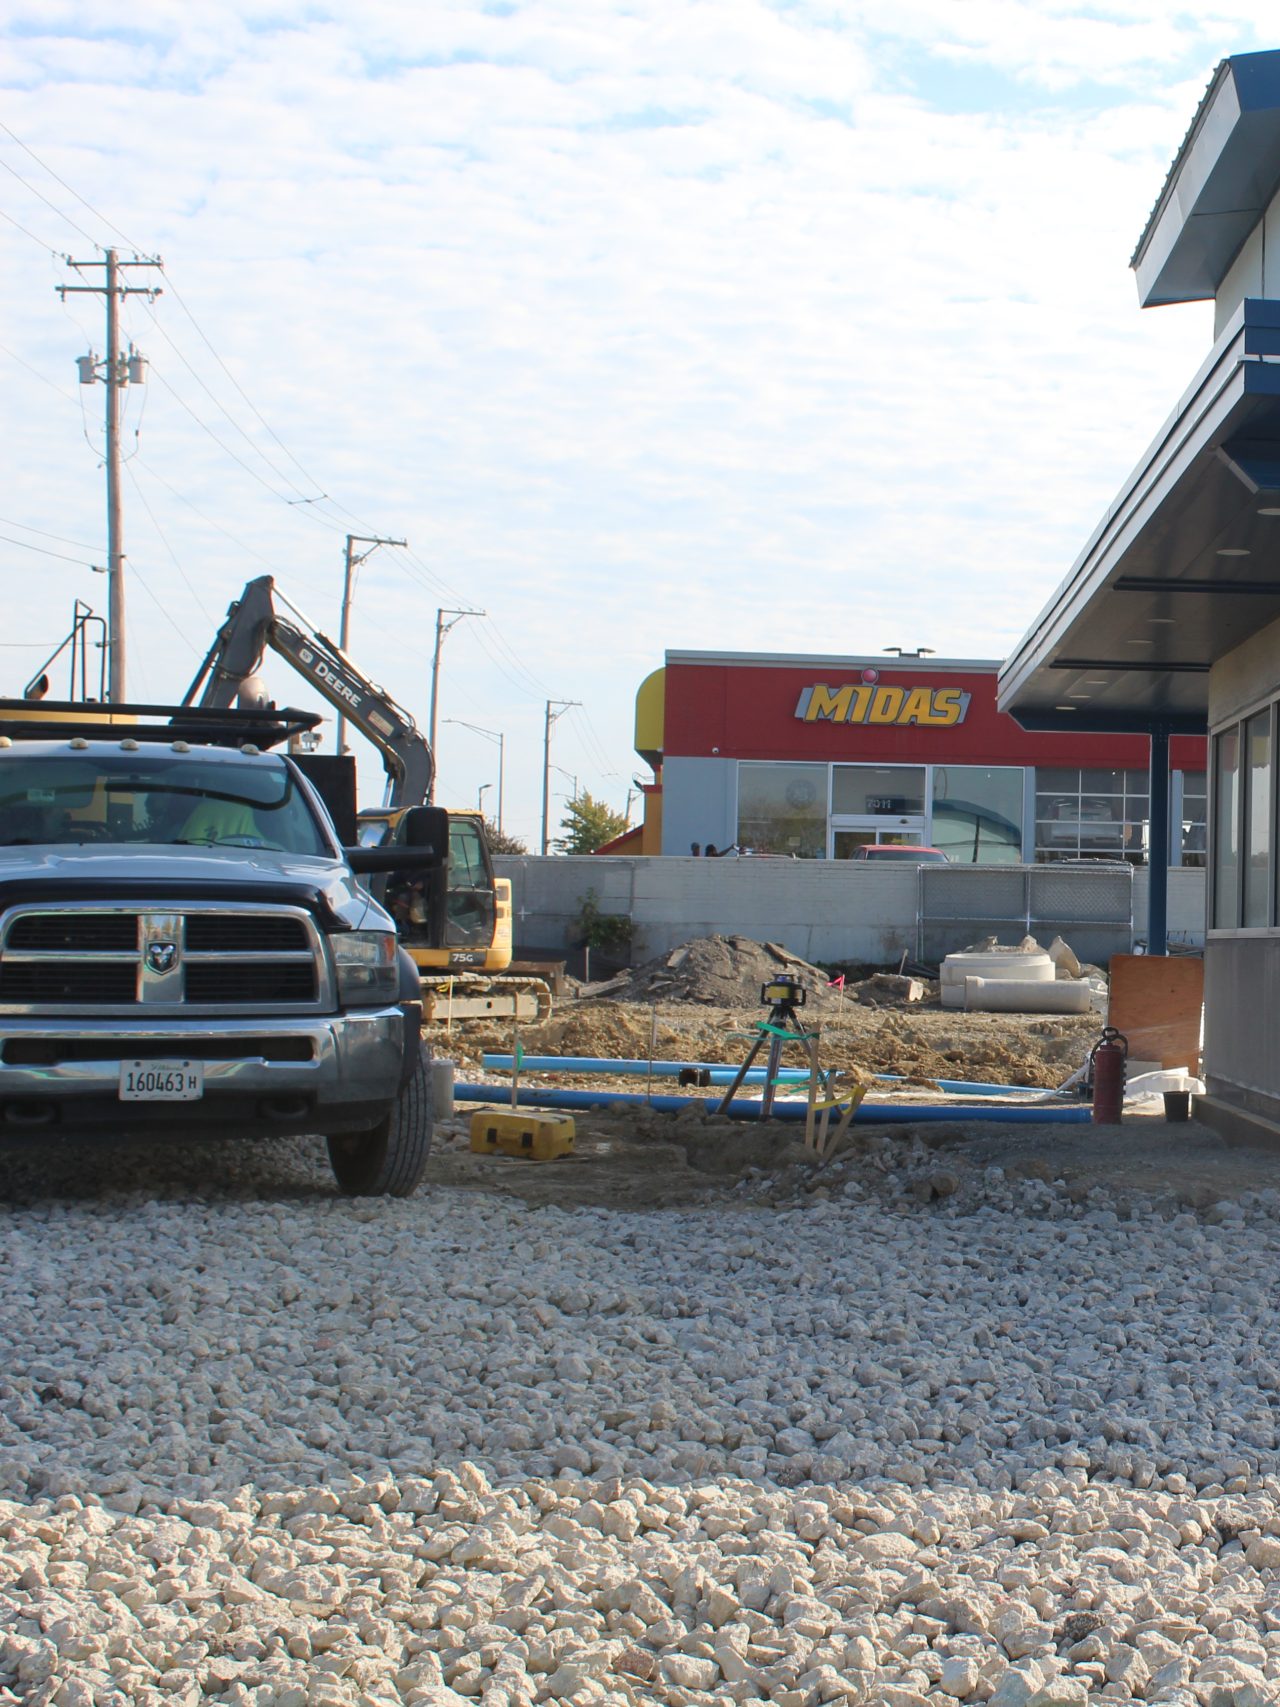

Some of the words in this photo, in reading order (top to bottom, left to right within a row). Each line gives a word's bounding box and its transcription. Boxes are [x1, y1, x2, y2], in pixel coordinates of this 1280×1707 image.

[315, 661, 362, 708] DEERE
[804, 684, 963, 726] MIDAS
[452, 953, 473, 962] 75G
[126, 1072, 184, 1092] 160463
[188, 1075, 197, 1089] H
